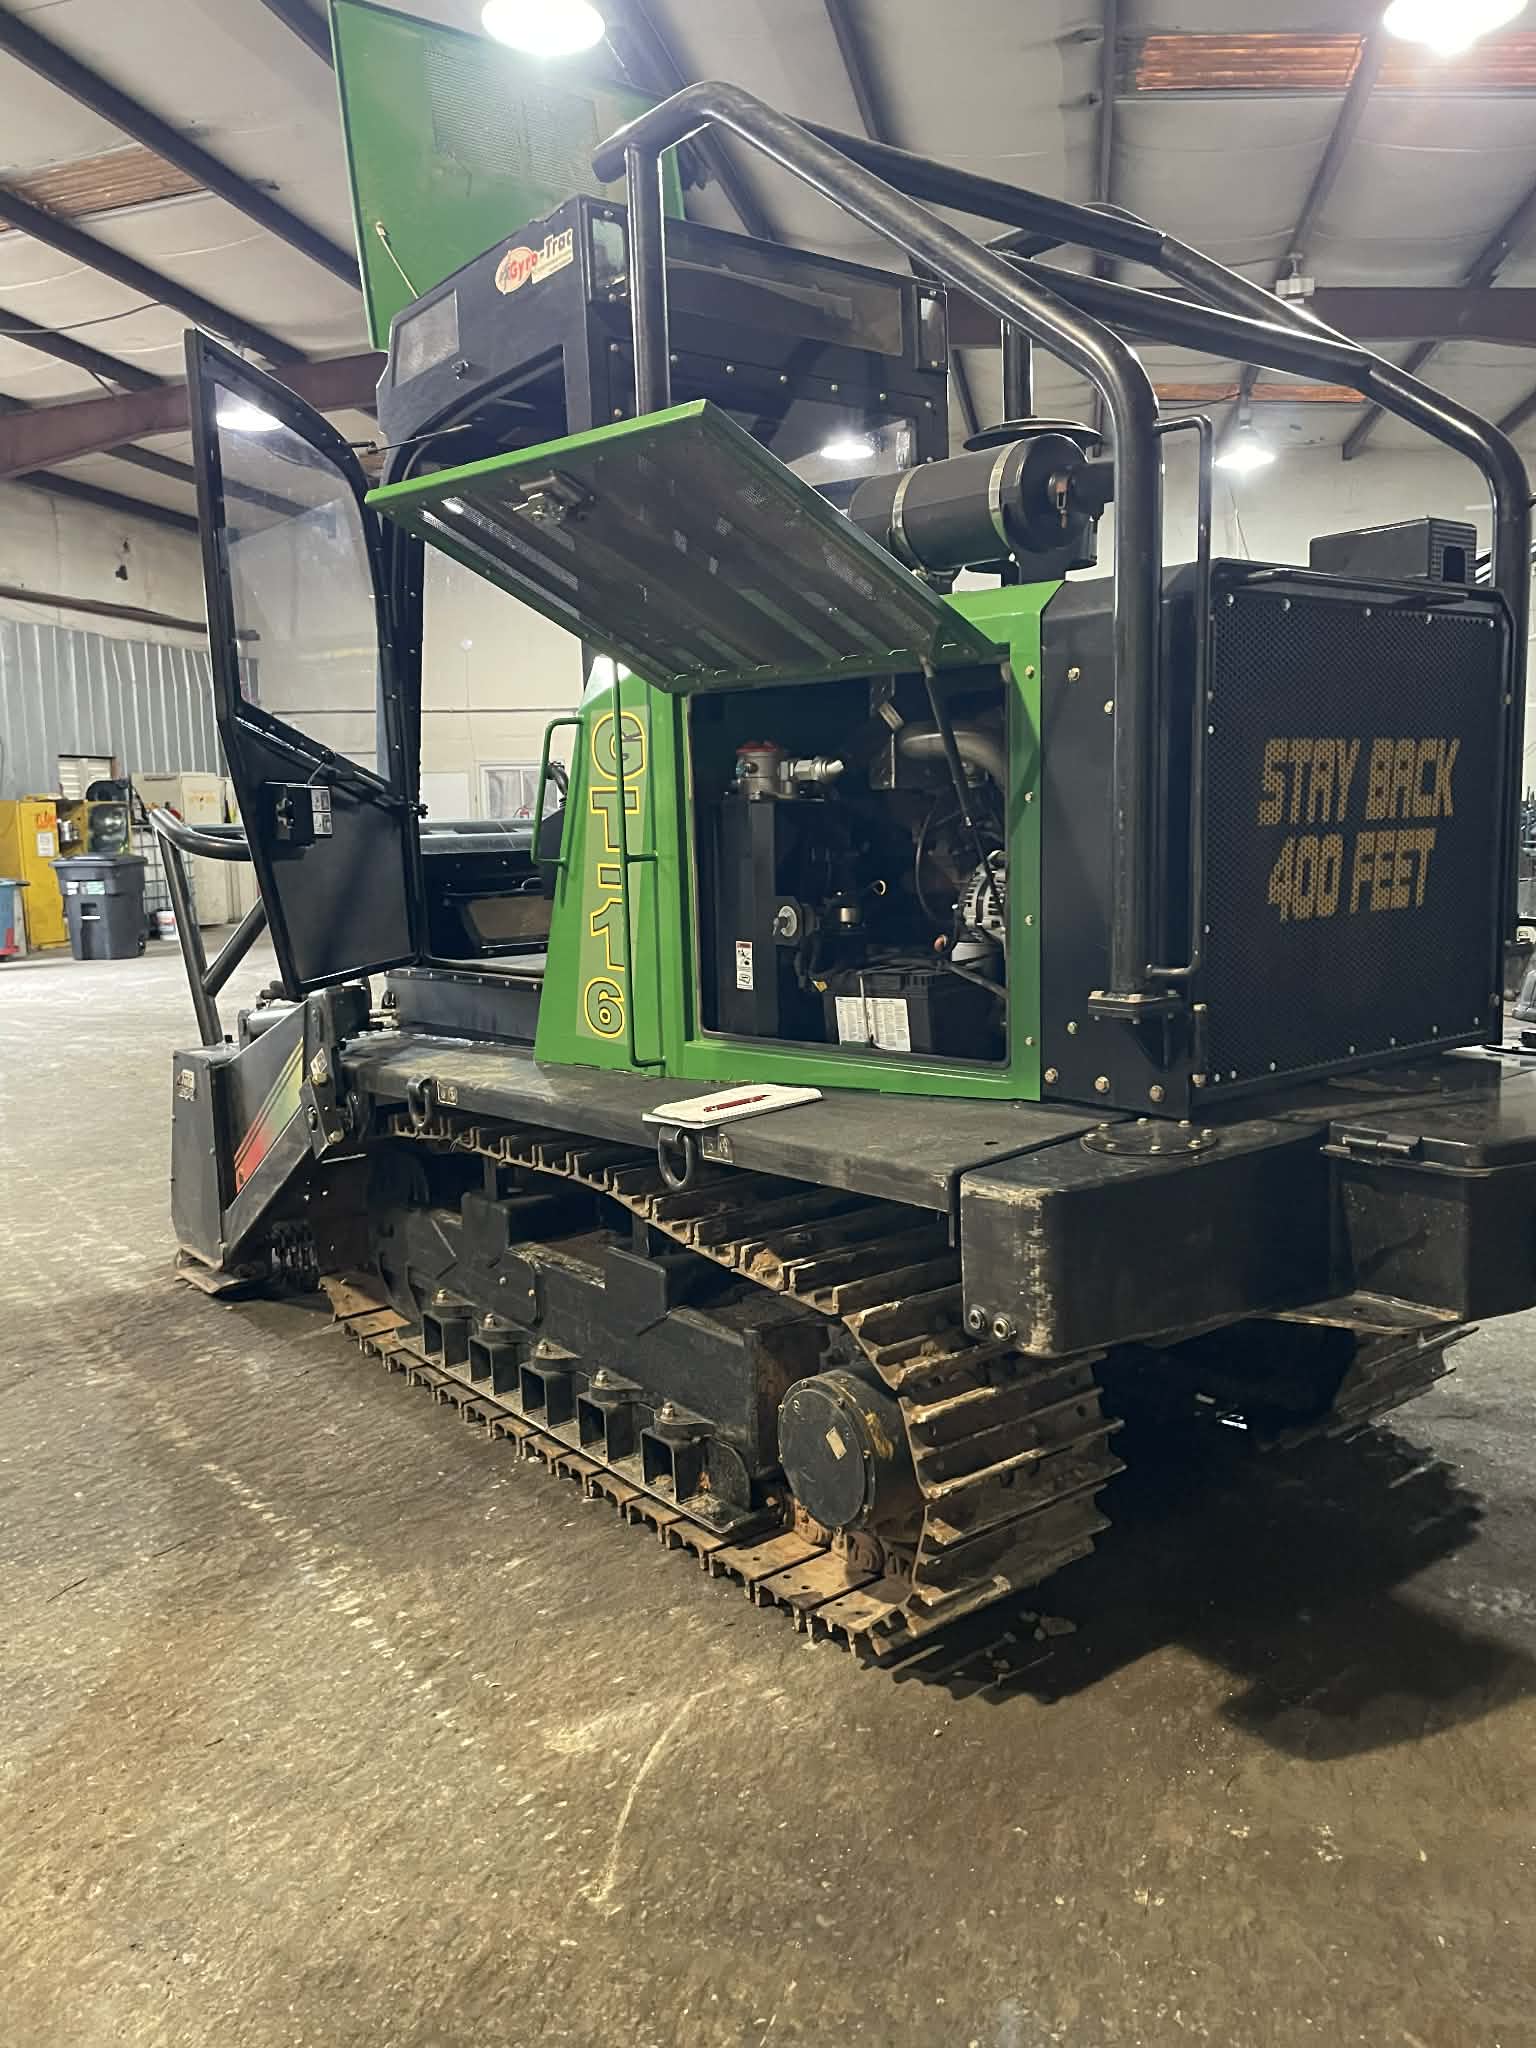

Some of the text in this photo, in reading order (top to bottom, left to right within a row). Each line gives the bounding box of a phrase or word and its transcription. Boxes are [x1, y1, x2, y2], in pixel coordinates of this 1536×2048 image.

[1257, 737, 1461, 825] STAY BACK
[584, 711, 647, 1039] GT-16
[1267, 827, 1437, 922] 400 FEET
